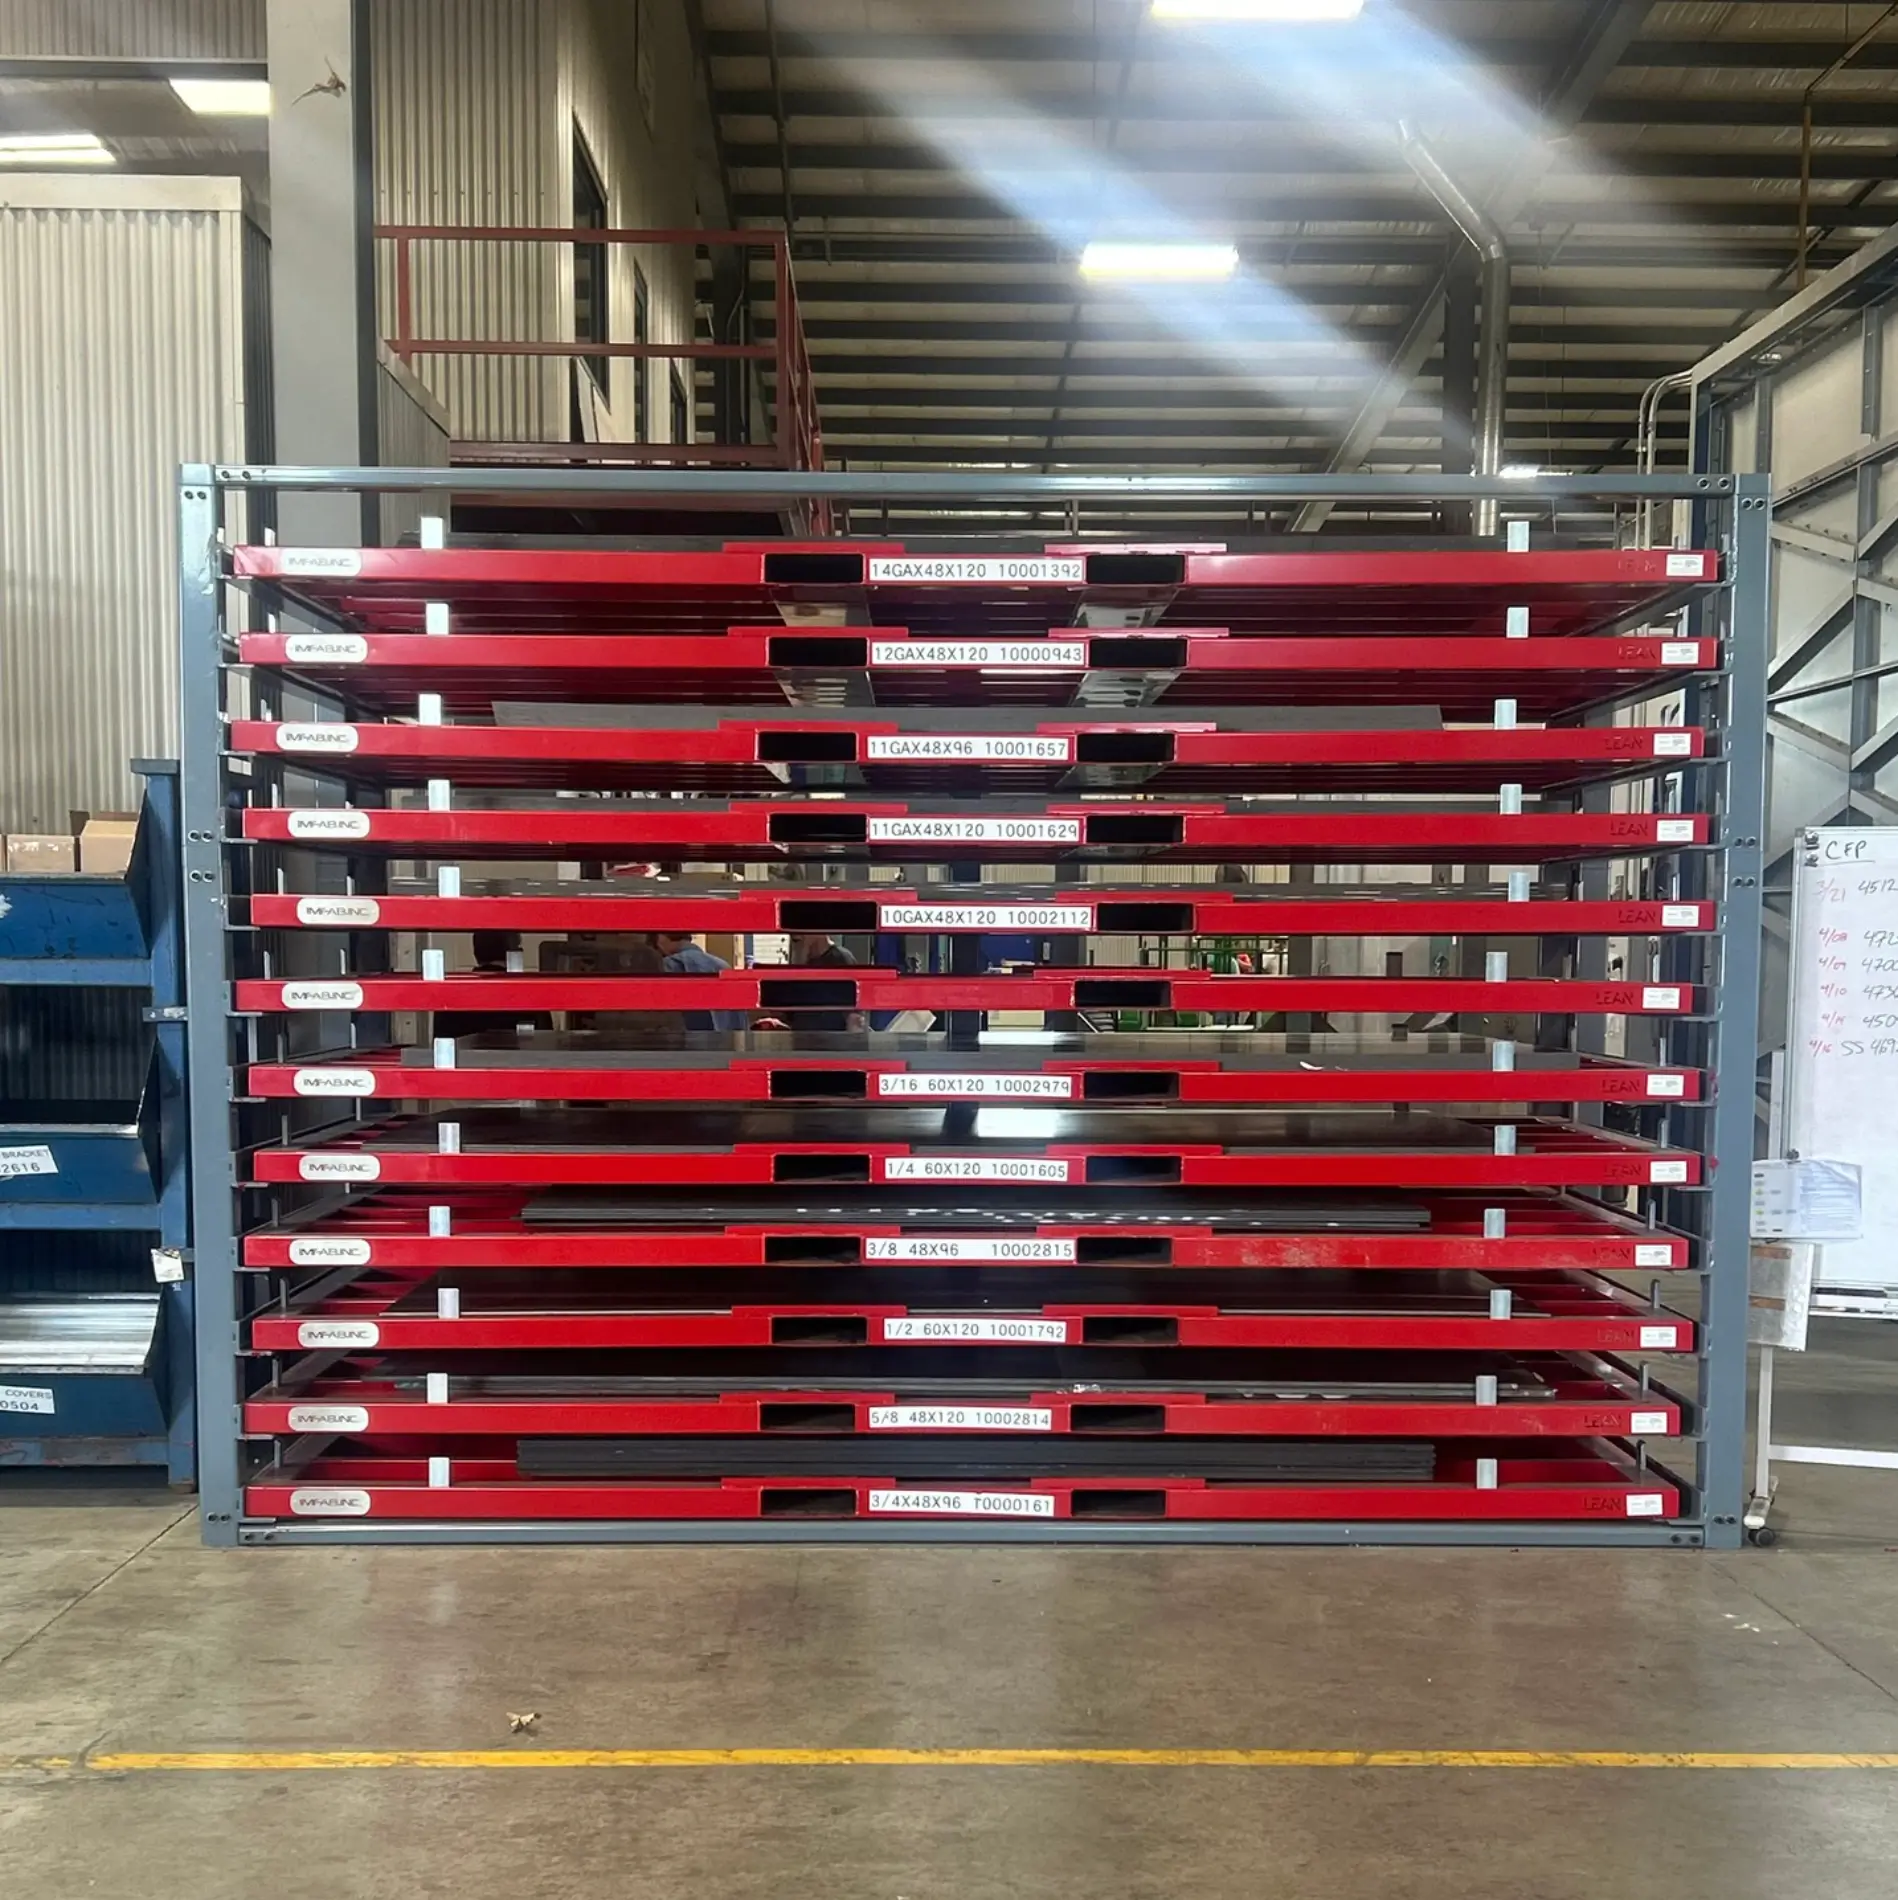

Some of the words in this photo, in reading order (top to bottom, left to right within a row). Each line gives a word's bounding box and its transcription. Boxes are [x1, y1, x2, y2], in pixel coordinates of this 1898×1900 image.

[872, 562, 987, 578] 14GAX48X120
[999, 563, 1081, 578] 10001392
[874, 646, 989, 662] 12GAX48X120
[1000, 646, 1083, 662] 10000943
[870, 739, 973, 756] 11GAX48X96
[985, 740, 1067, 756] 10001657
[871, 821, 985, 837] 11GAX48X120
[996, 822, 1078, 838] 10001629
[1609, 821, 1649, 837] LEAN
[883, 909, 997, 925] 10GAX48X120
[1008, 909, 1090, 925] 10002112
[1617, 908, 1657, 924] LEAN
[1595, 991, 1634, 1006] LEAN
[880, 1077, 918, 1093] 3/16
[927, 1078, 985, 1093] 60X120
[994, 1078, 1071, 1094] 10002979
[1601, 1078, 1641, 1093] LEAN
[887, 1161, 915, 1175] 1/4
[924, 1161, 982, 1176] 60X120
[992, 1162, 1067, 1179] 10001605
[867, 1241, 898, 1257] 3/8
[908, 1241, 960, 1257] 48X96
[991, 1242, 1073, 1257] 10002815
[886, 1321, 914, 1337] 1/2
[922, 1322, 980, 1337] 60X120
[989, 1323, 1065, 1340] 10001792
[871, 1410, 899, 1425] 5/8
[908, 1410, 965, 1425] 48X120
[975, 1411, 1050, 1427] 10002814
[871, 1494, 962, 1510] 3/4X48X96
[1583, 1496, 1623, 1511] LEAN
